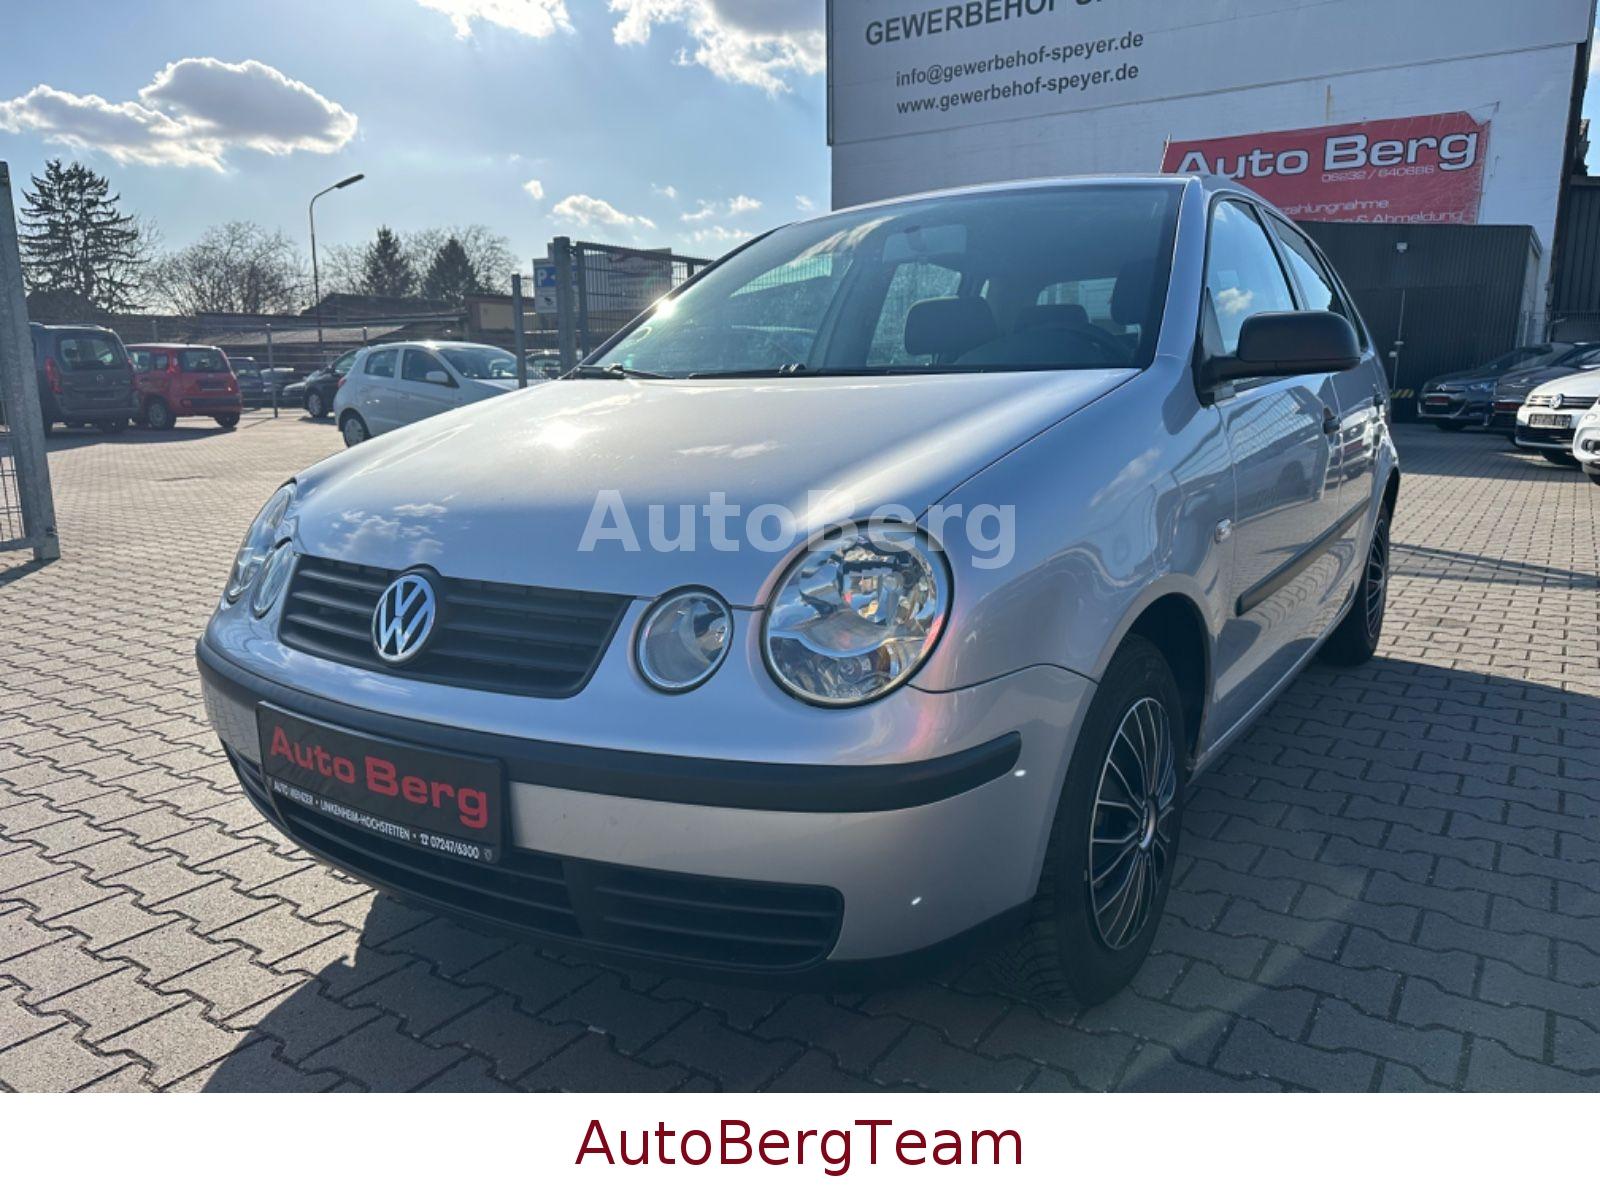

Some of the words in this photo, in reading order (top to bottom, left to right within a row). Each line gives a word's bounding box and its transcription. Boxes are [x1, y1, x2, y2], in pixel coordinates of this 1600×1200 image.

[896, 31, 1144, 87] info@gewerbehof-speyer.de
[896, 64, 1139, 114] www.gewerbehof-speyer.de
[1177, 149, 1309, 180] Auto
[1323, 132, 1479, 172] Berg
[270, 726, 356, 785] Auto
[364, 755, 489, 830] Berg
